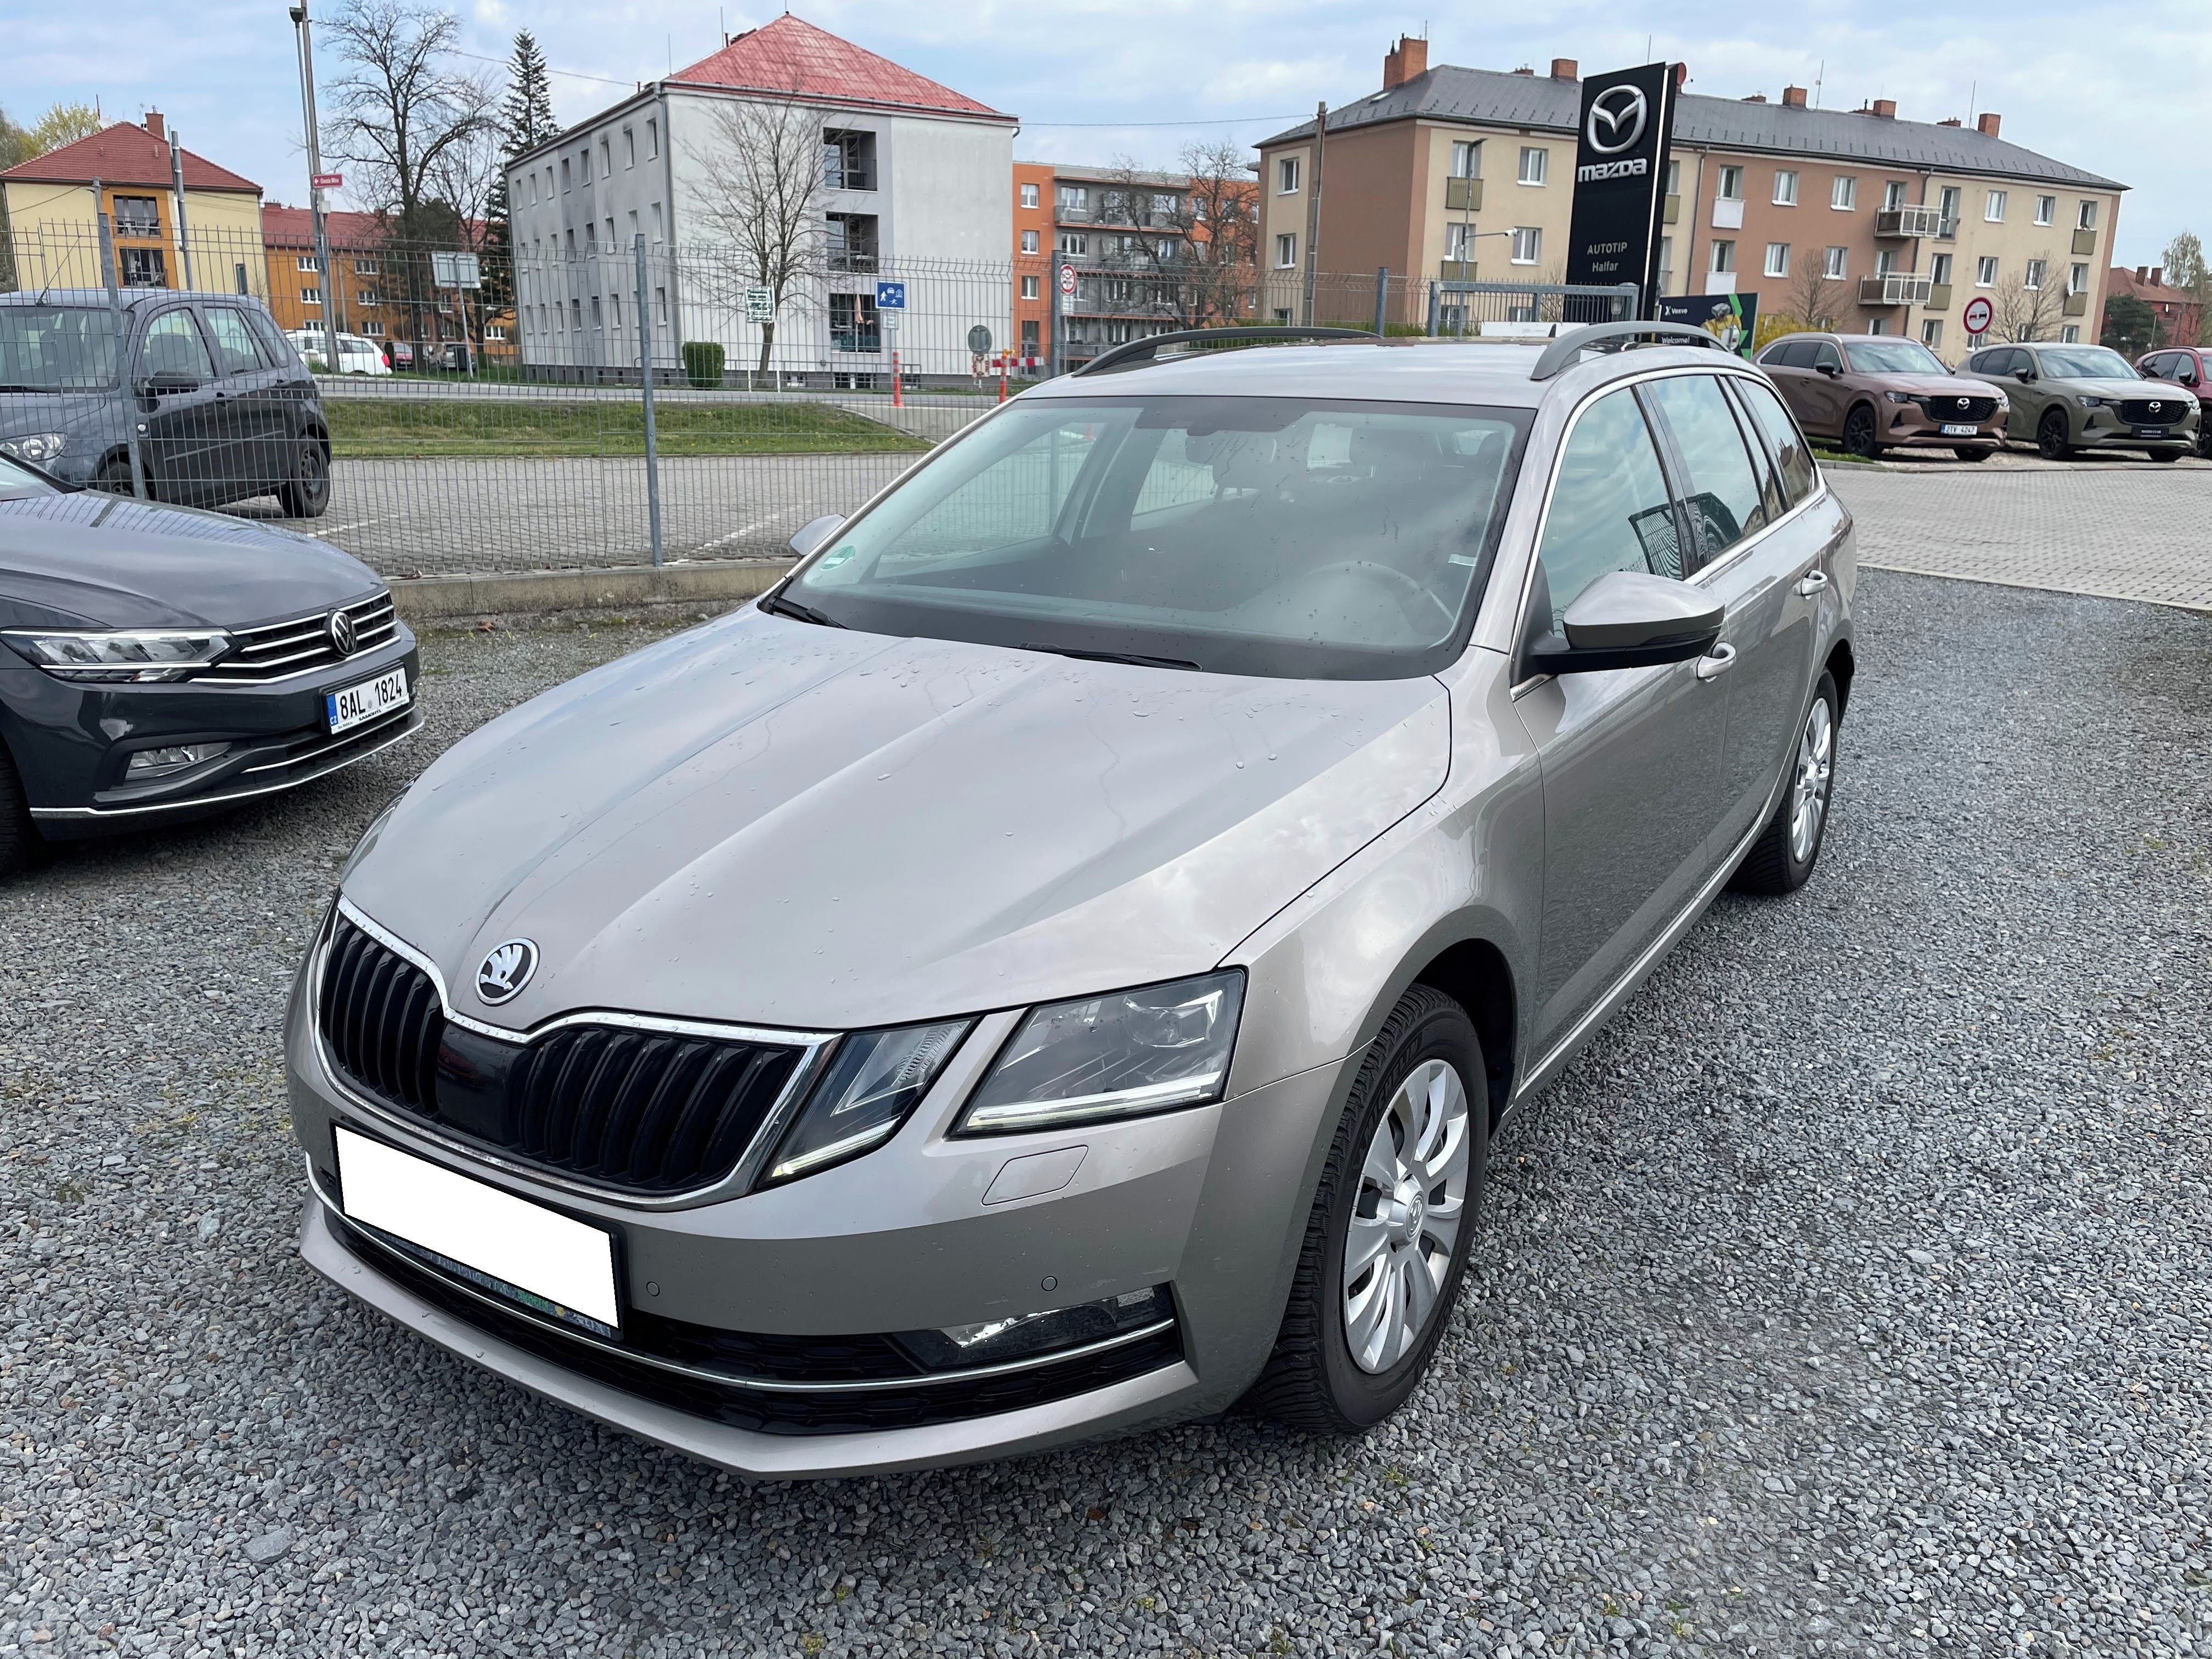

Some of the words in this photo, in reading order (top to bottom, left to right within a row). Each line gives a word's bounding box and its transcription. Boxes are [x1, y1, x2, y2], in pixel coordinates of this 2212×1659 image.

[1587, 242, 1628, 255] AUTOTIP
[1592, 261, 1619, 272] Halfar
[1662, 336, 1690, 344] Welcome!
[340, 690, 366, 719] 8AL
[375, 674, 402, 706] 1824
